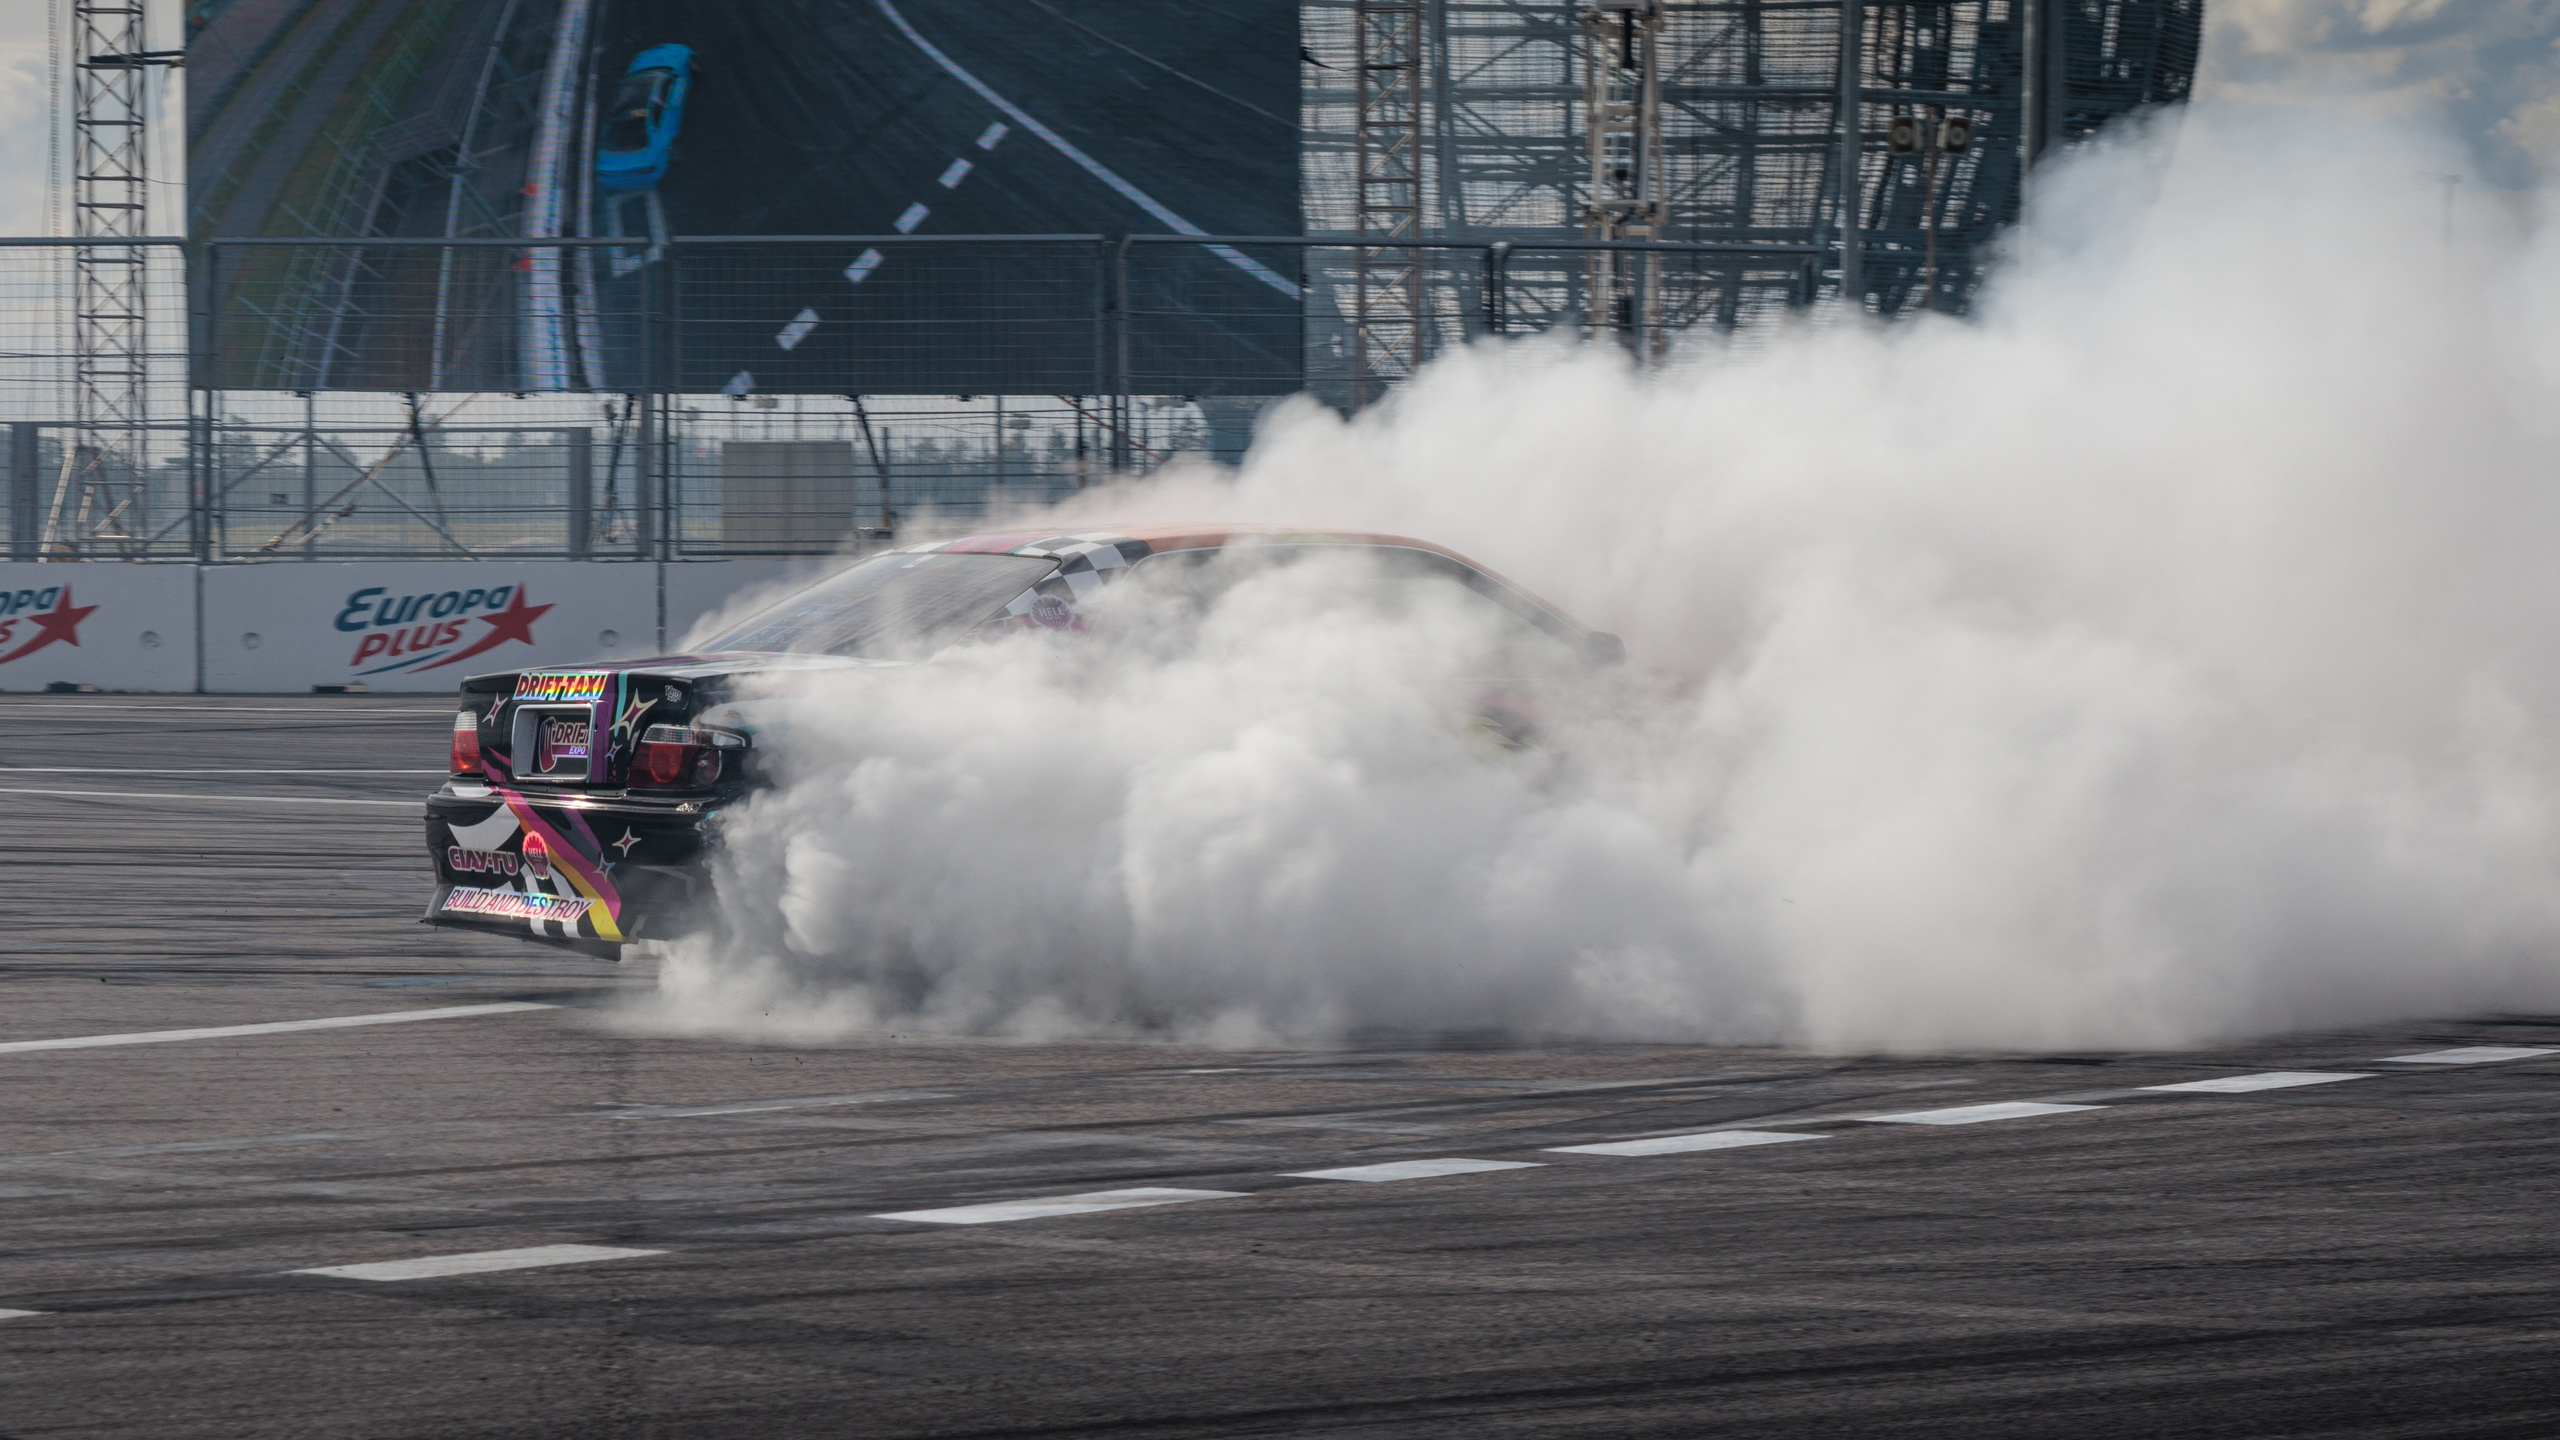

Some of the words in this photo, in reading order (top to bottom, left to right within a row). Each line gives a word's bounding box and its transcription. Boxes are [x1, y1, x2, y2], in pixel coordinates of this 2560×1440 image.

[1039, 606, 1065, 617] HELL
[513, 673, 566, 700] DRIFT
[561, 673, 608, 700] TAXI
[569, 746, 586, 755] EXPO
[528, 847, 543, 859] HELL
[444, 888, 489, 909] BUILD
[483, 892, 519, 913] AND
[514, 894, 593, 920] DESTROY
